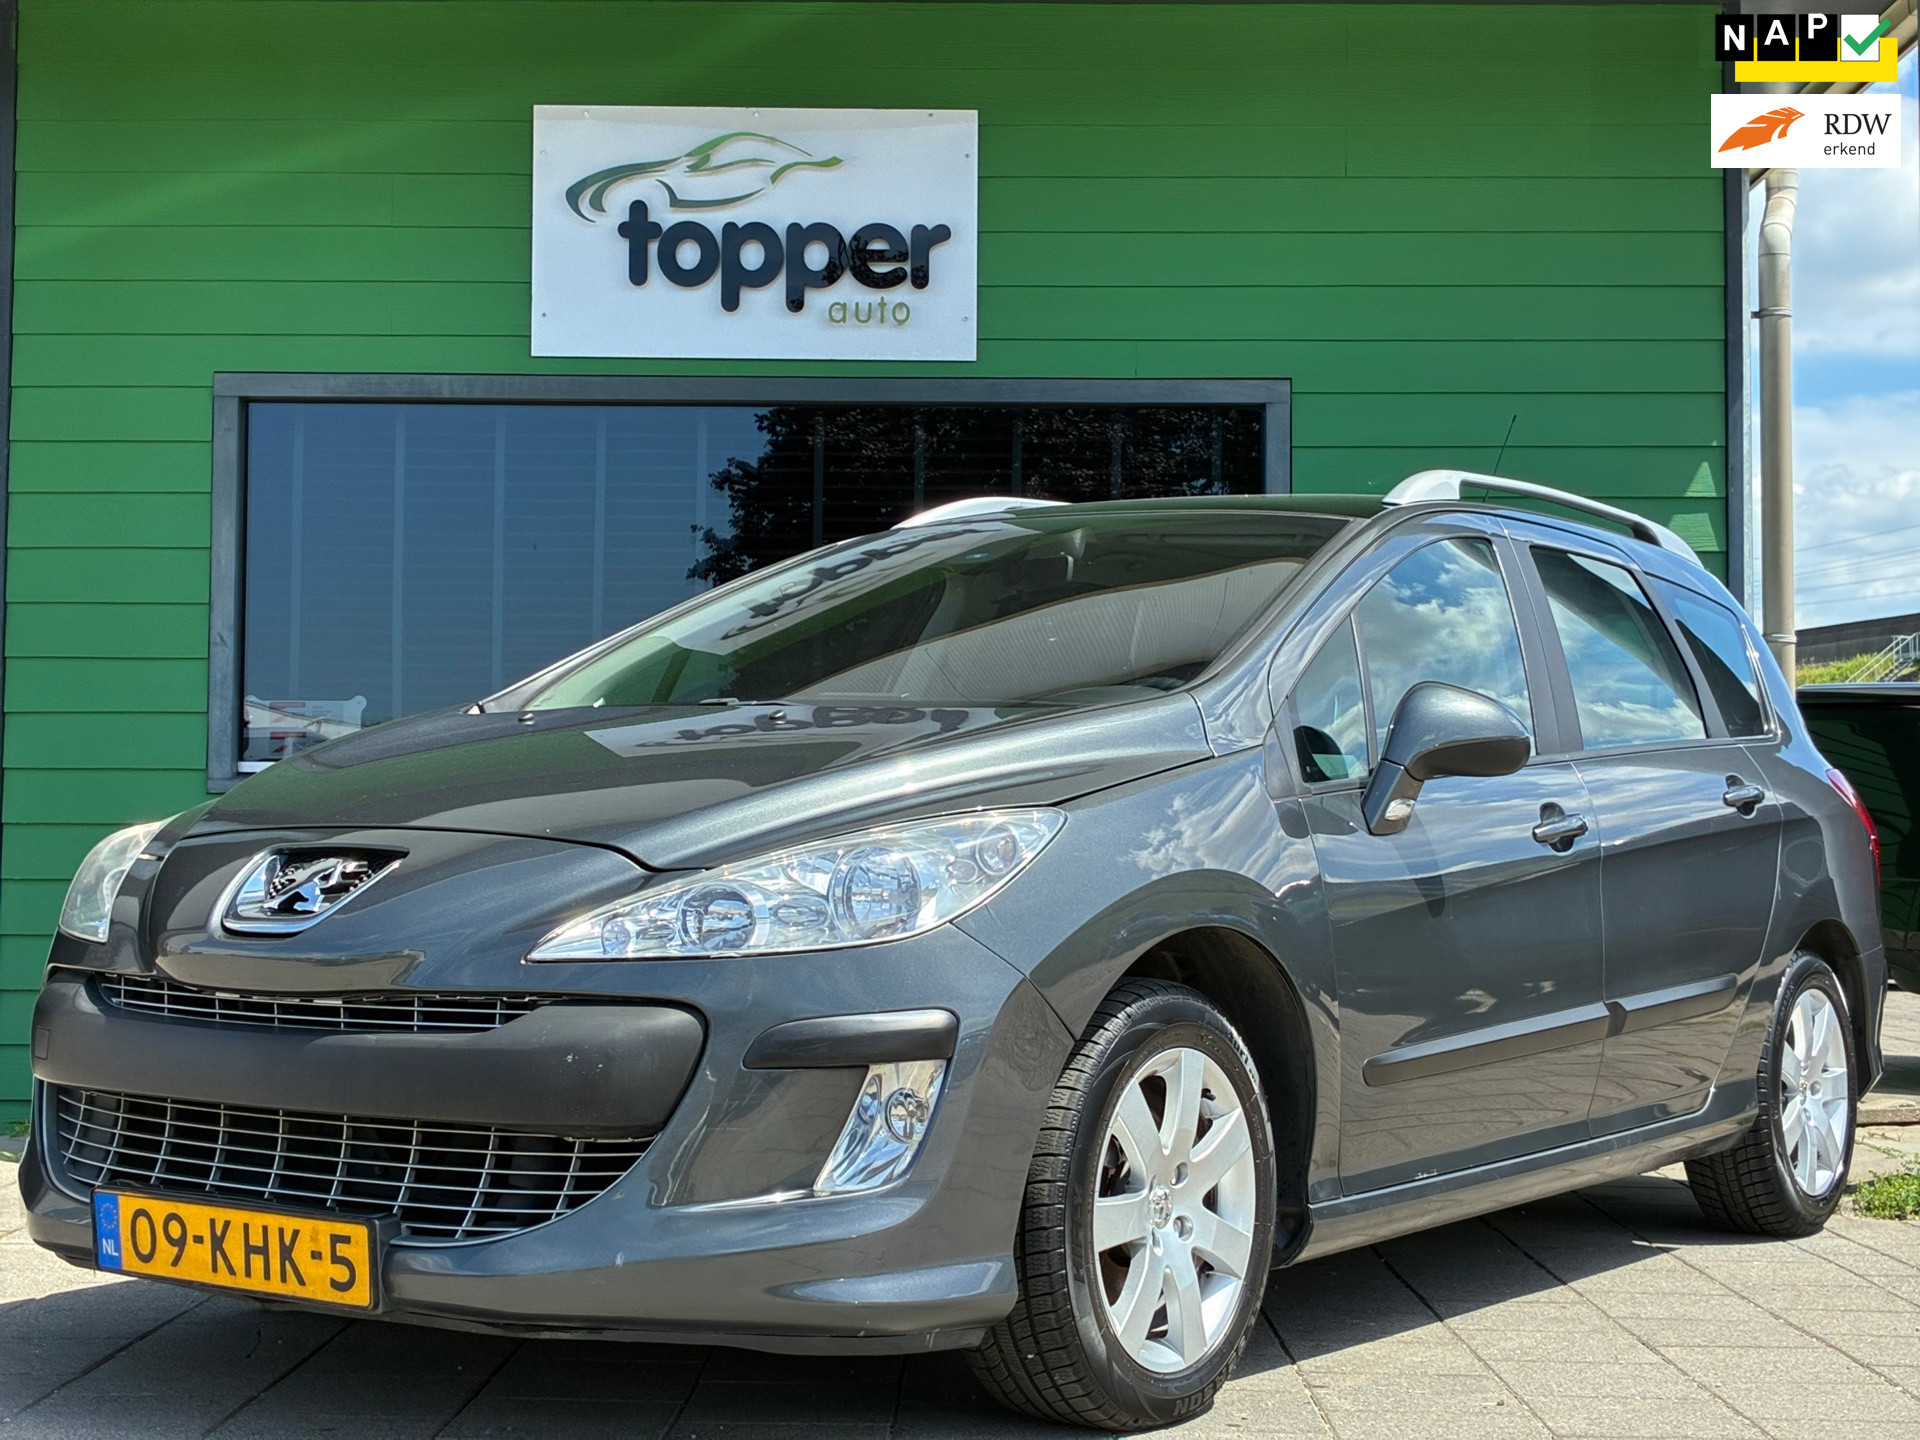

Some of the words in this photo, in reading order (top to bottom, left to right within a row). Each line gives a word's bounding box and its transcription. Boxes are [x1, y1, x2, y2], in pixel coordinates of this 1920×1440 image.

[617, 199, 952, 313] topper
[827, 296, 911, 326] auto
[102, 1238, 119, 1256] NL
[130, 1208, 357, 1293] 09-KHK-5
